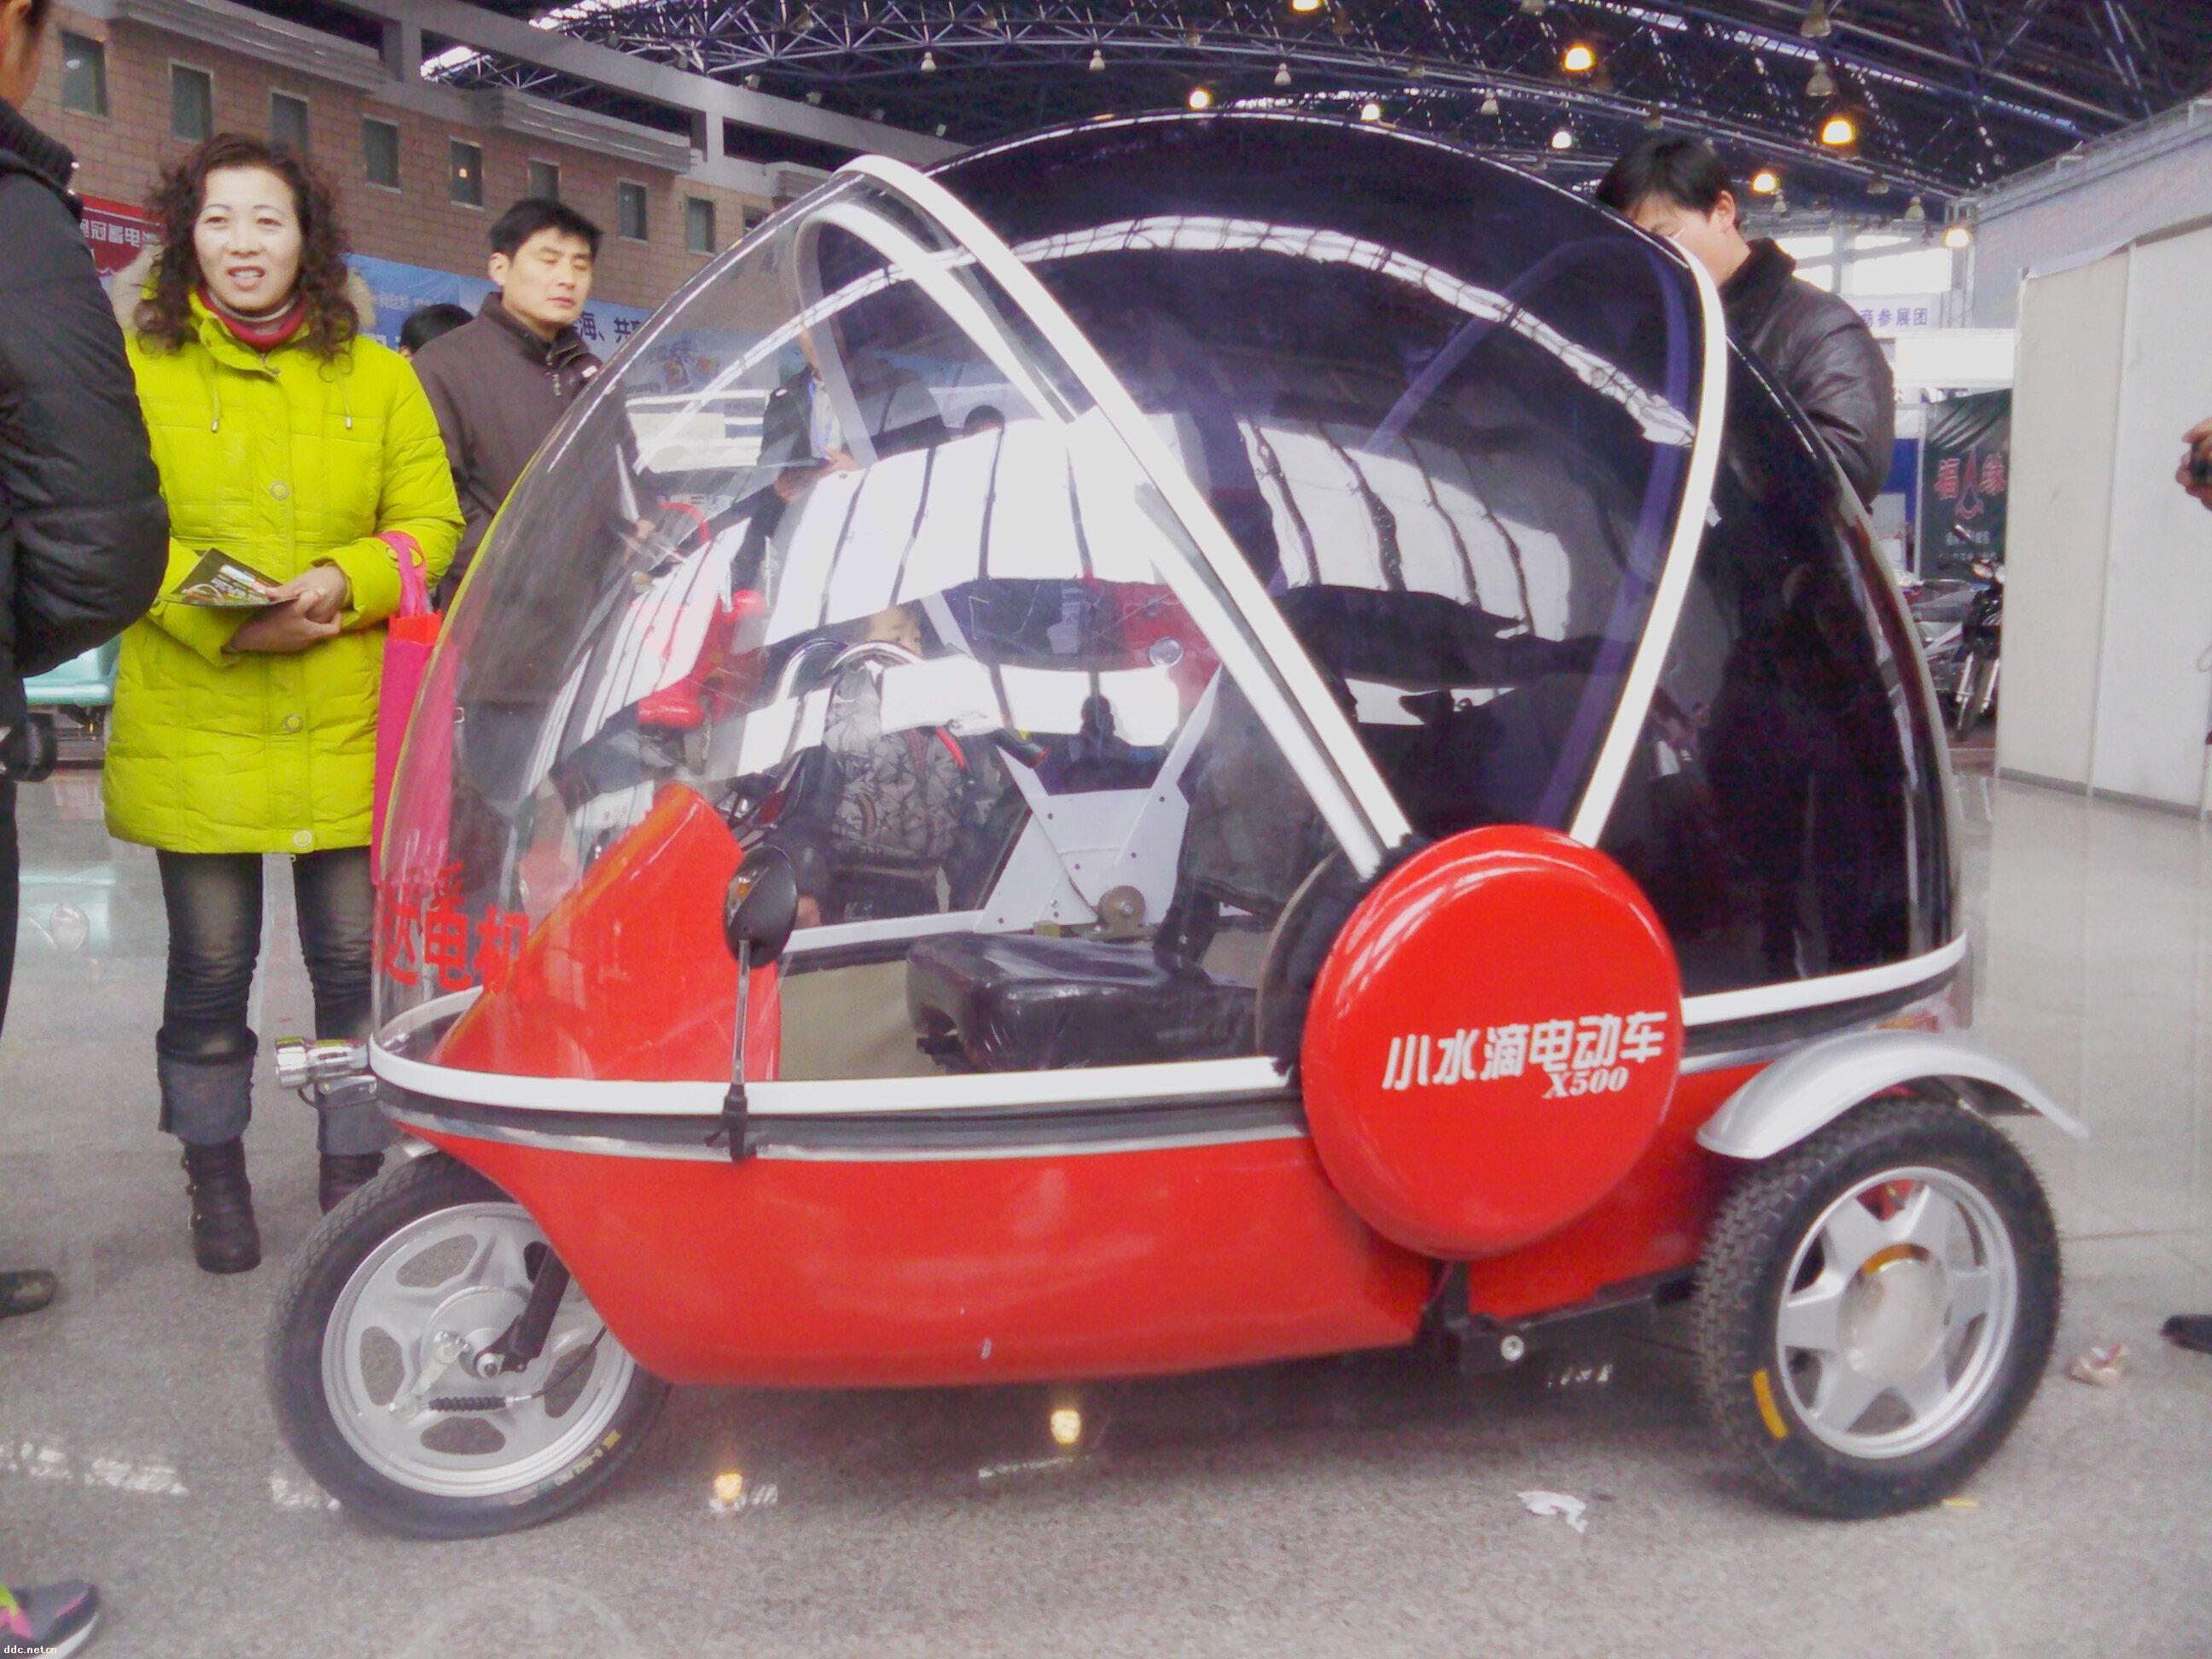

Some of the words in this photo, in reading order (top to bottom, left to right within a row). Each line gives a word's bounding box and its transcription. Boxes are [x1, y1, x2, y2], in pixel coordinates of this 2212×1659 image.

[1382, 1010, 1668, 1091] 小水滴电动车
[1542, 1067, 1629, 1100] X500
